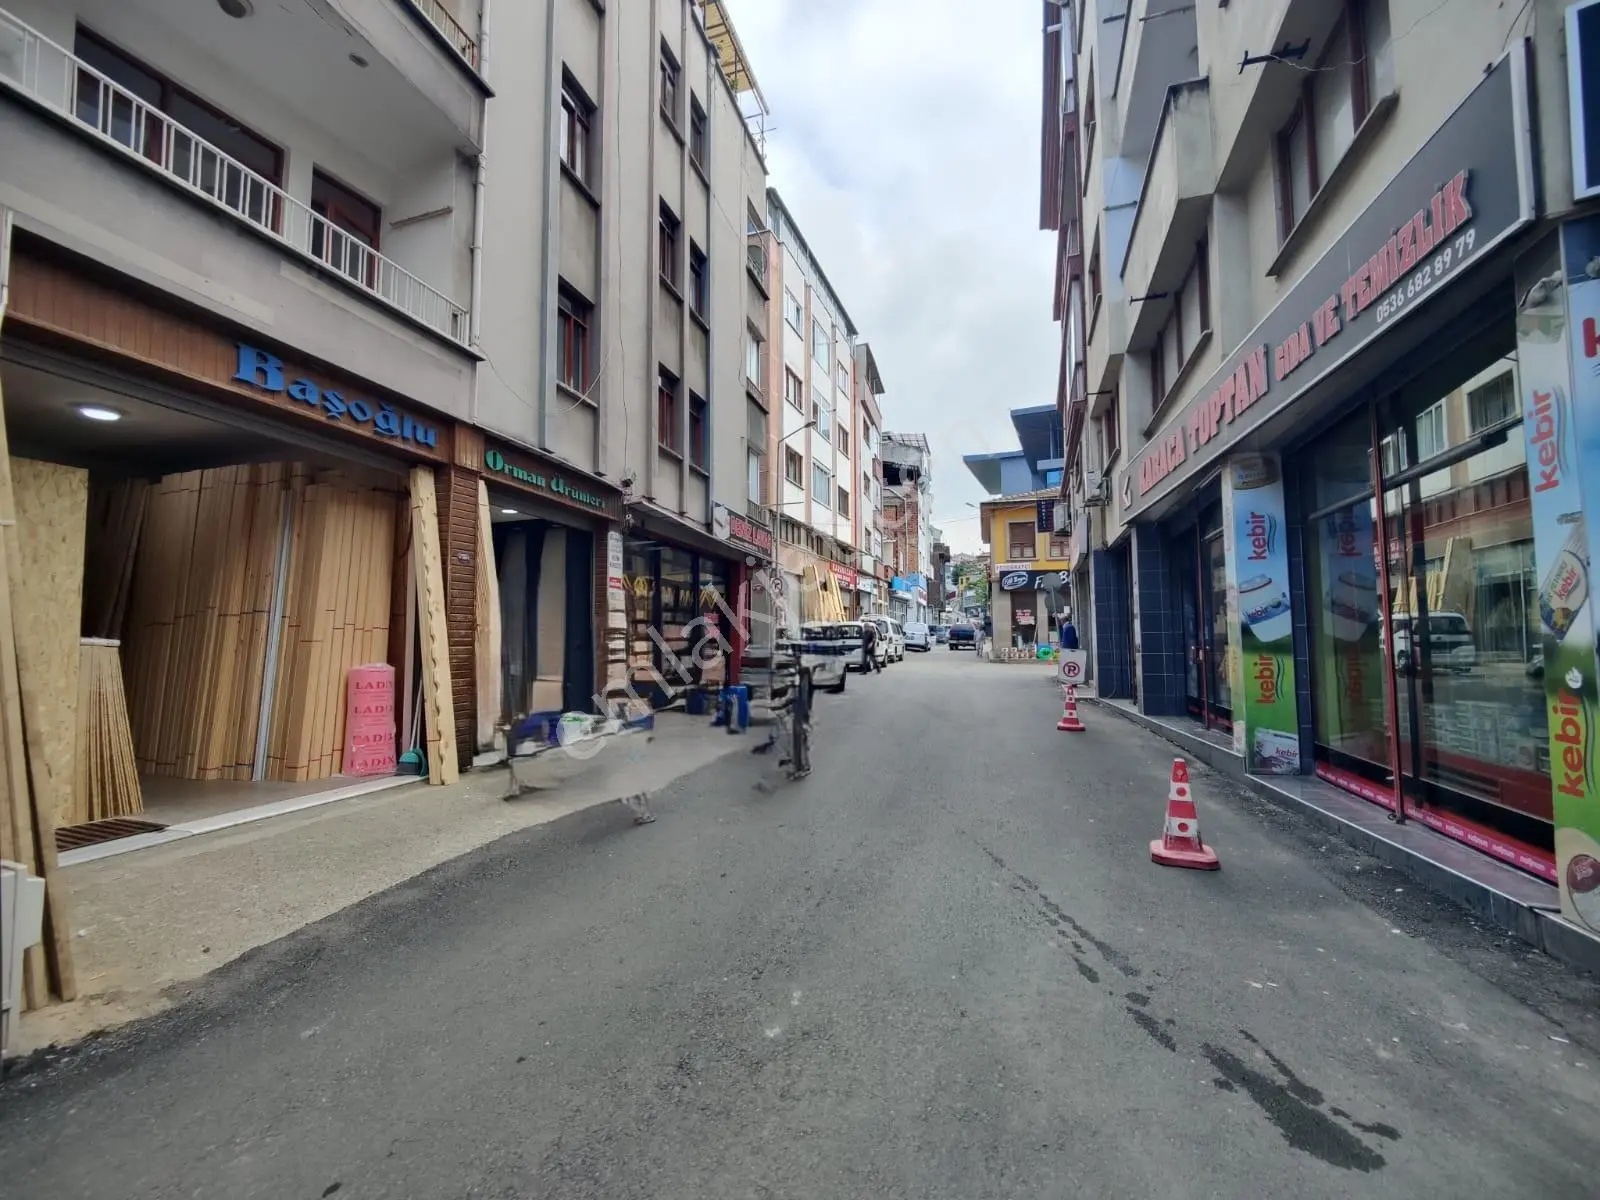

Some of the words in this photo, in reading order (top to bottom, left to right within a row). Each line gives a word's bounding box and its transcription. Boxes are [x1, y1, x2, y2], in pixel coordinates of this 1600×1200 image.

[1376, 288, 1404, 323] 0536
[1407, 265, 1431, 298] 682
[1434, 248, 1452, 276] 89
[1456, 228, 1476, 259] 79
[1139, 426, 1187, 496] KARACA
[1188, 343, 1269, 453] TOPTAN
[1274, 321, 1314, 381] GIDA
[1313, 293, 1342, 346] VE
[1341, 168, 1472, 321] TEMİZLİK
[231, 342, 437, 448] Başoğlu
[1528, 390, 1560, 492] kebir
[485, 449, 546, 488] Orman
[550, 472, 606, 508] Ürünleri
[1246, 511, 1267, 560] kebir
[1556, 566, 1578, 600] kebir
[1254, 653, 1275, 704] kebir
[1552, 688, 1585, 798] kebir
